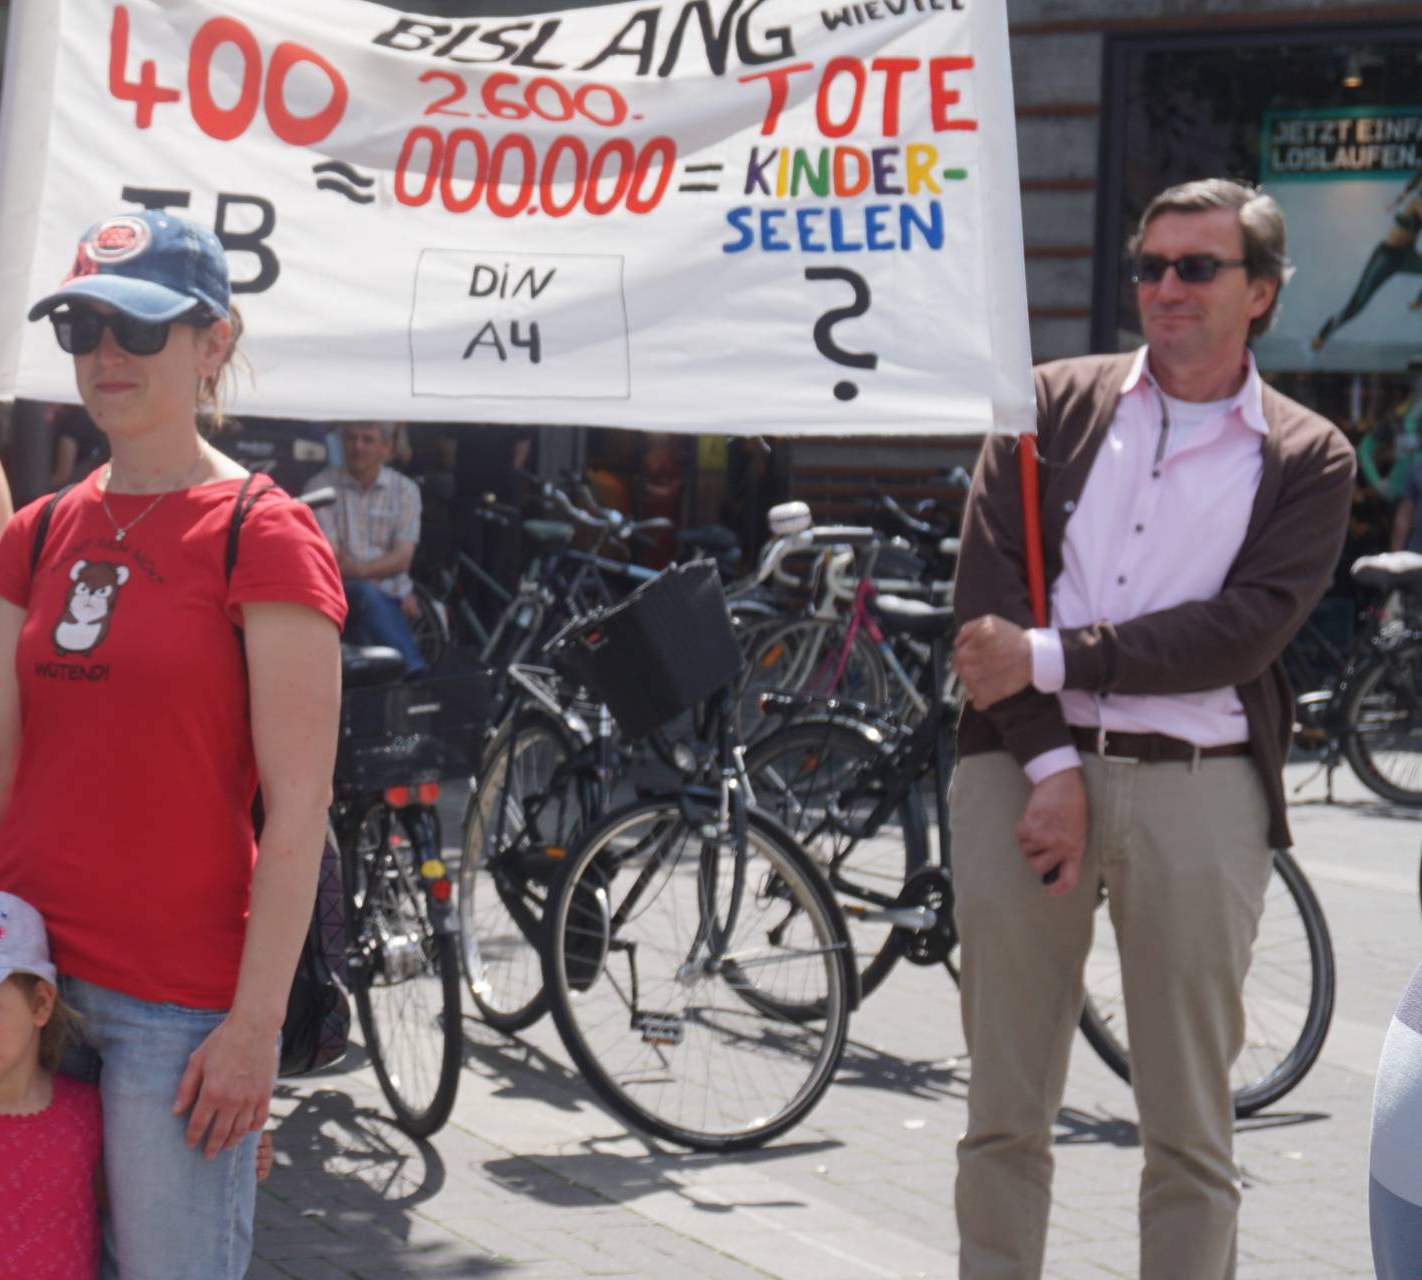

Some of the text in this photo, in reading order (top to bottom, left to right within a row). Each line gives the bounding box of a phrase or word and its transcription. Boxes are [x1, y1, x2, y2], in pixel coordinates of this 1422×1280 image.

[108, 4, 349, 147] 400
[372, 0, 795, 77] BISLANG
[738, 56, 978, 138] TOTE
[1273, 119, 1352, 145] JETZT
[394, 126, 677, 218] 000.000
[743, 144, 968, 197] KINDER-
[722, 201, 944, 253] SEELEN
[462, 319, 542, 364] A4
[804, 266, 878, 401] ?
